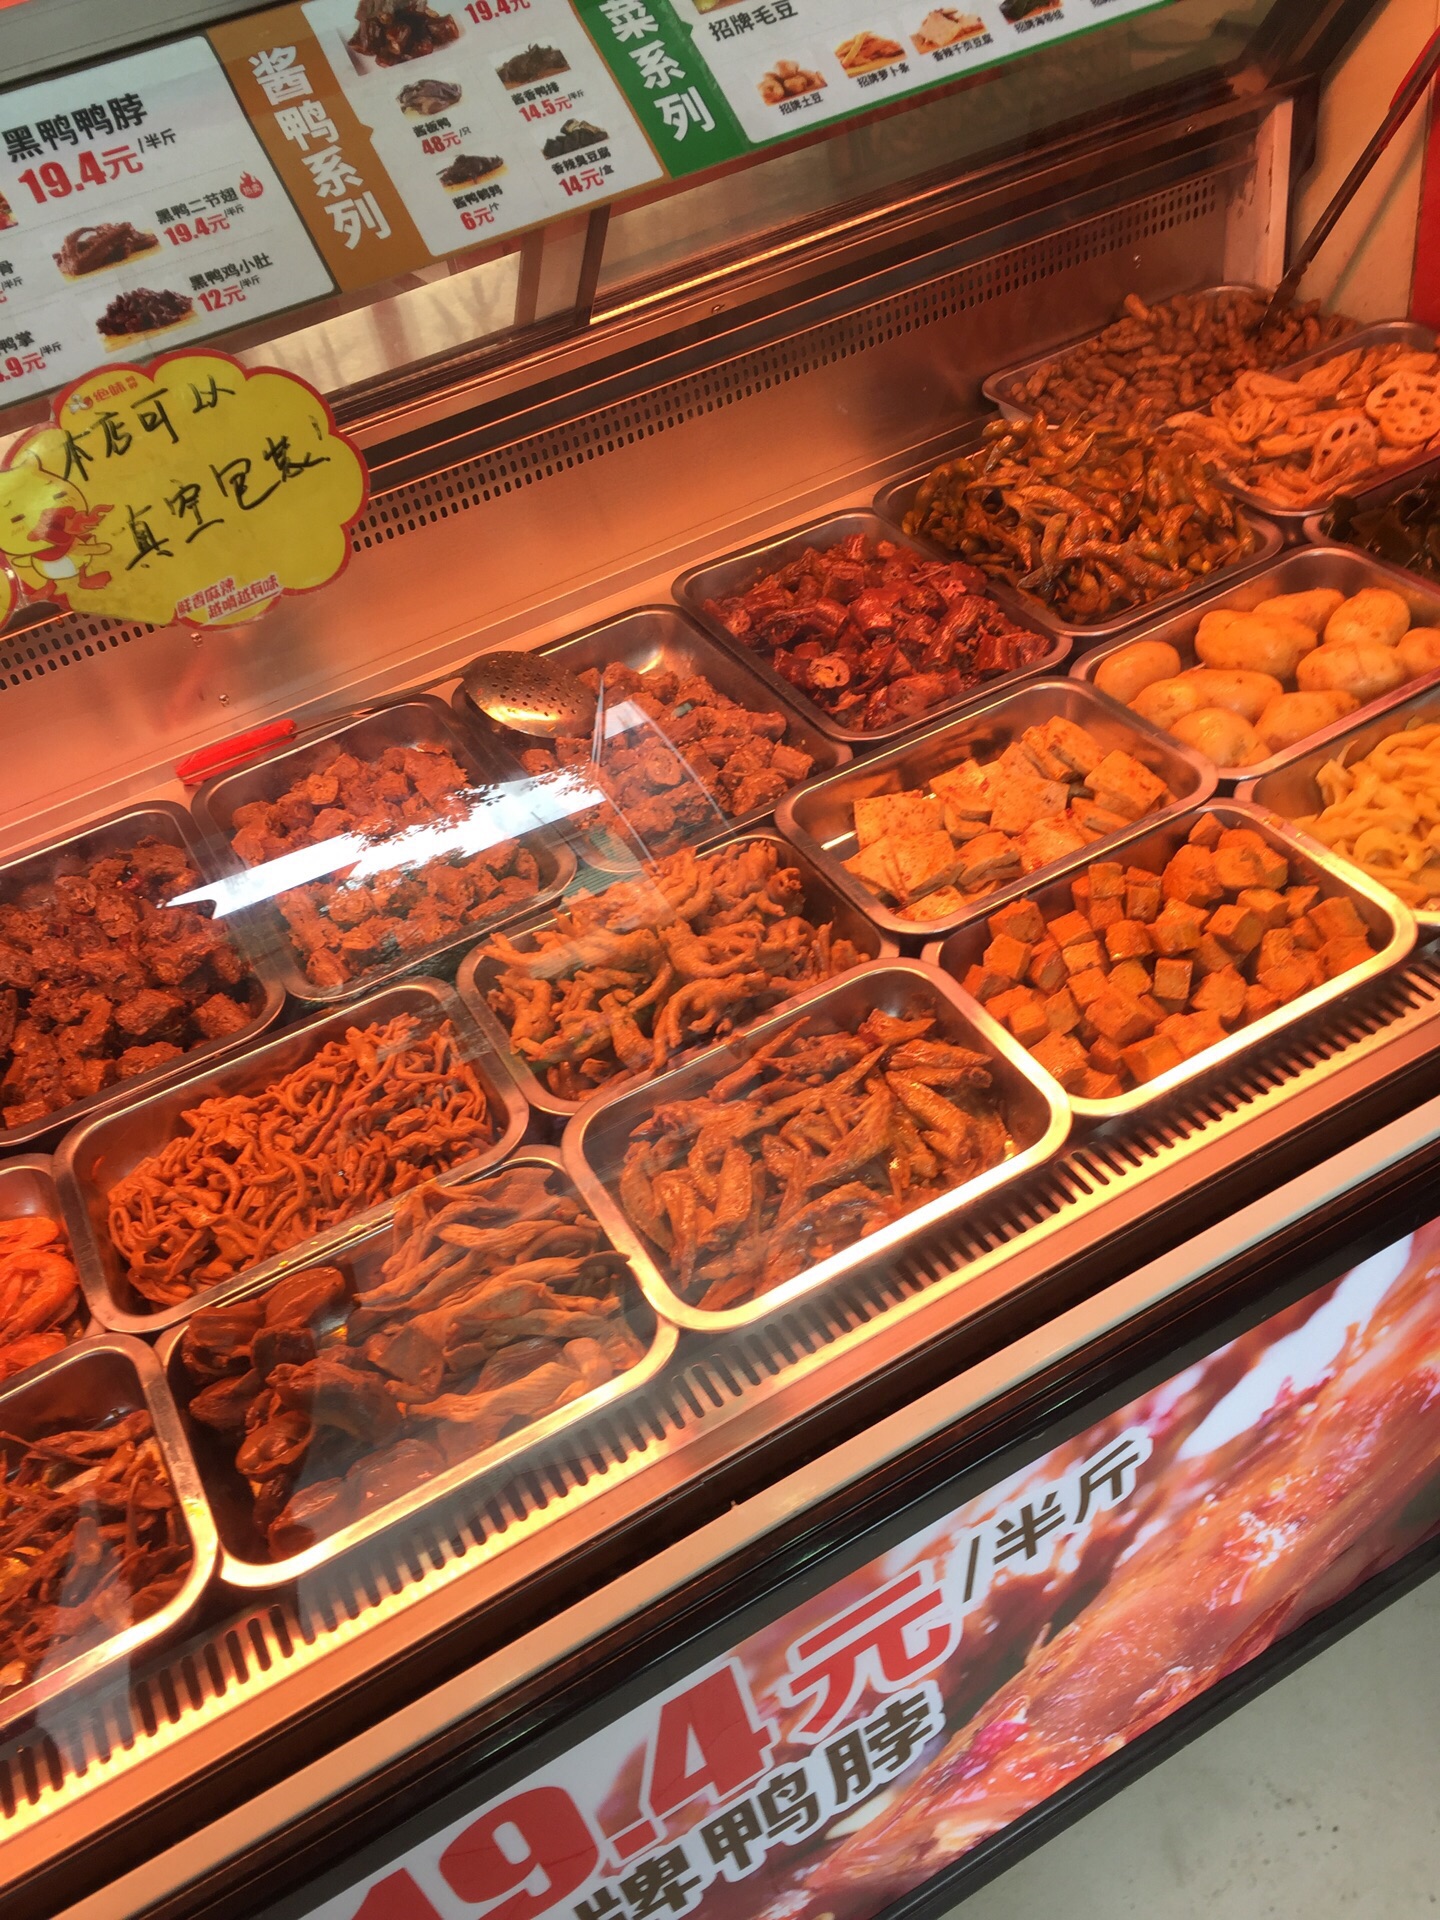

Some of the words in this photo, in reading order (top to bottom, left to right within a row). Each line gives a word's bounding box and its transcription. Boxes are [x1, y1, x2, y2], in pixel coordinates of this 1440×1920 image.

[708, 0, 799, 42] 招牌毛豆
[598, 0, 716, 142] 菜系列
[1, 93, 148, 163] 黑鸭鸭脖
[778, 92, 824, 116] 招牌土豆
[248, 46, 392, 250] 酱鸭系列
[155, 187, 239, 224] 黑鸭二节翅
[189, 252, 273, 291] 黑鸭鸡小肚
[63, 374, 236, 481] 本店可以
